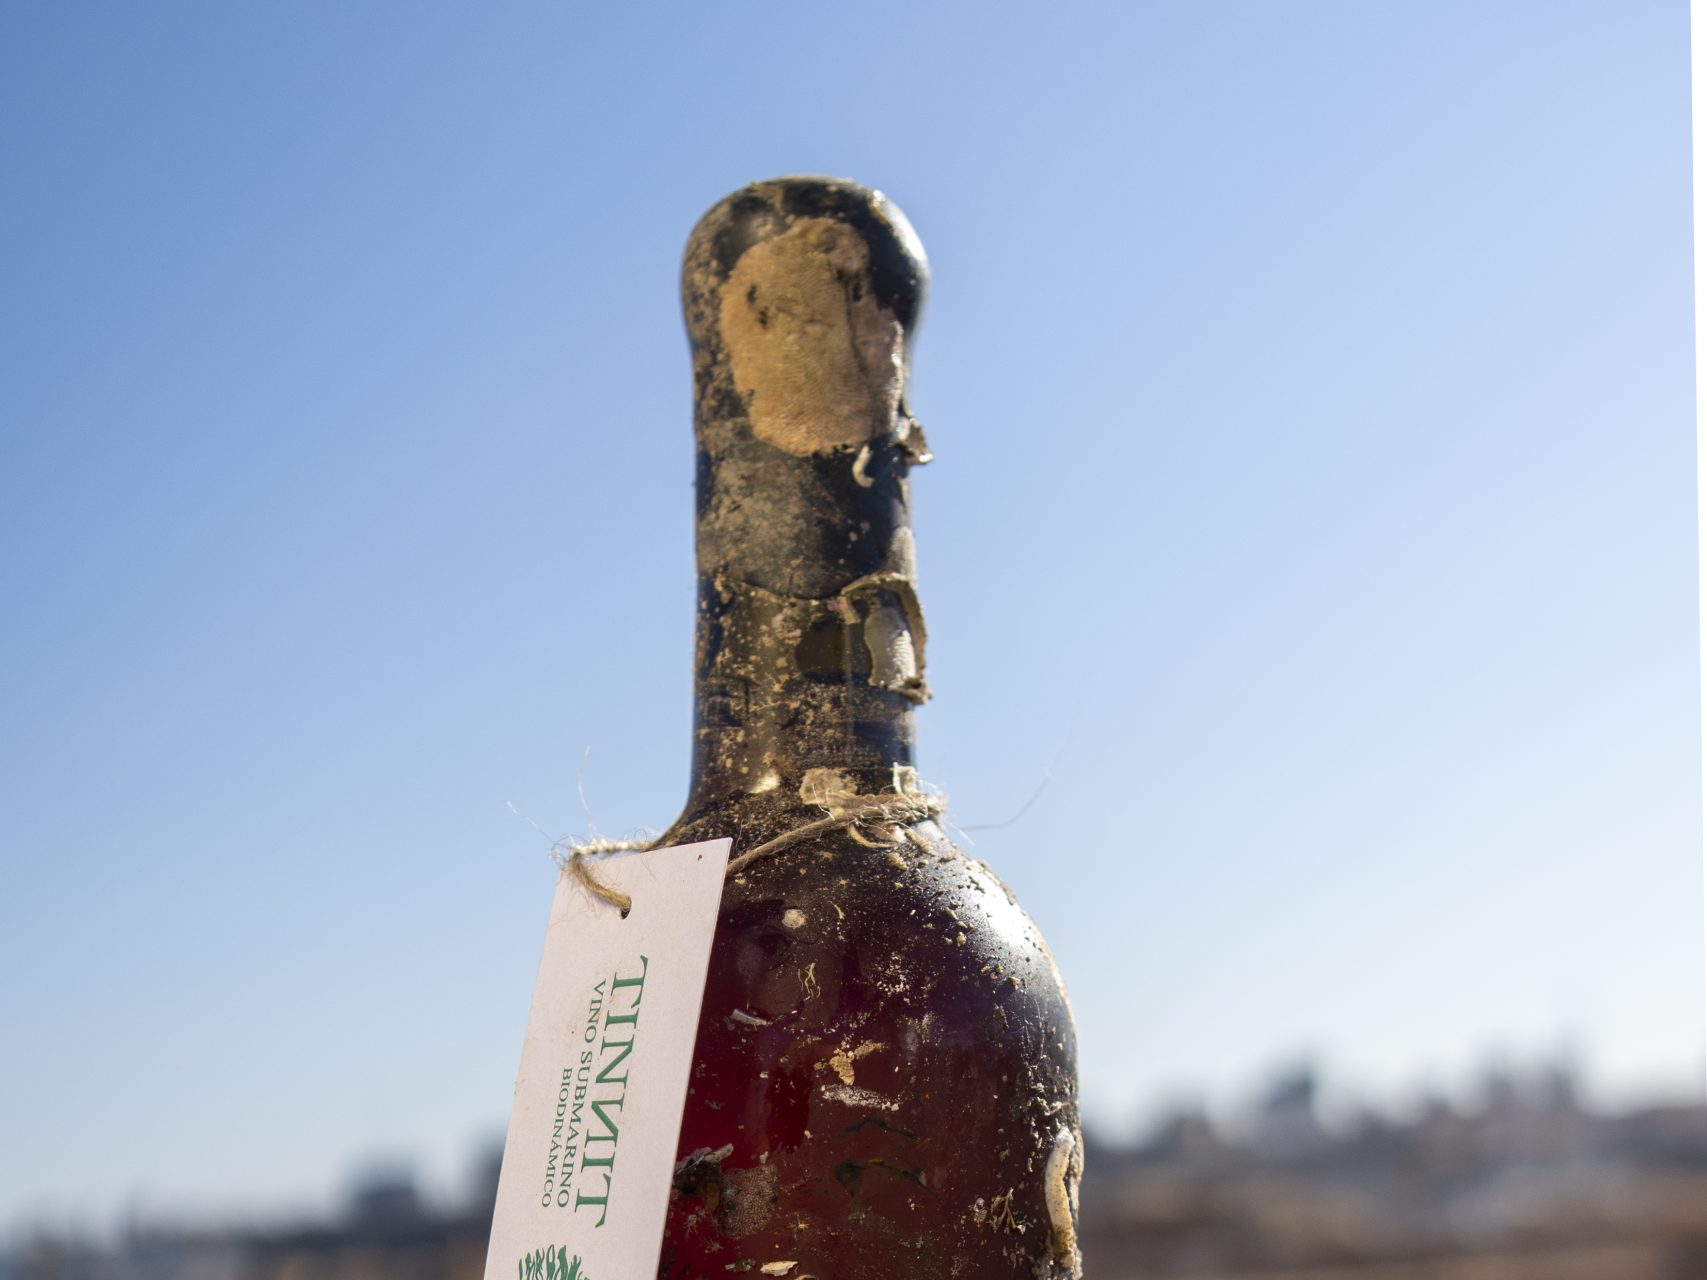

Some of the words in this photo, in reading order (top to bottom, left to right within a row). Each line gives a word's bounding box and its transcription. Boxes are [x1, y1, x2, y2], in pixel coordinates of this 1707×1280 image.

[584, 978, 607, 1044] VINO
[541, 1067, 573, 1209] BIODINÁMICO
[556, 1050, 593, 1209] SUBMARINO
